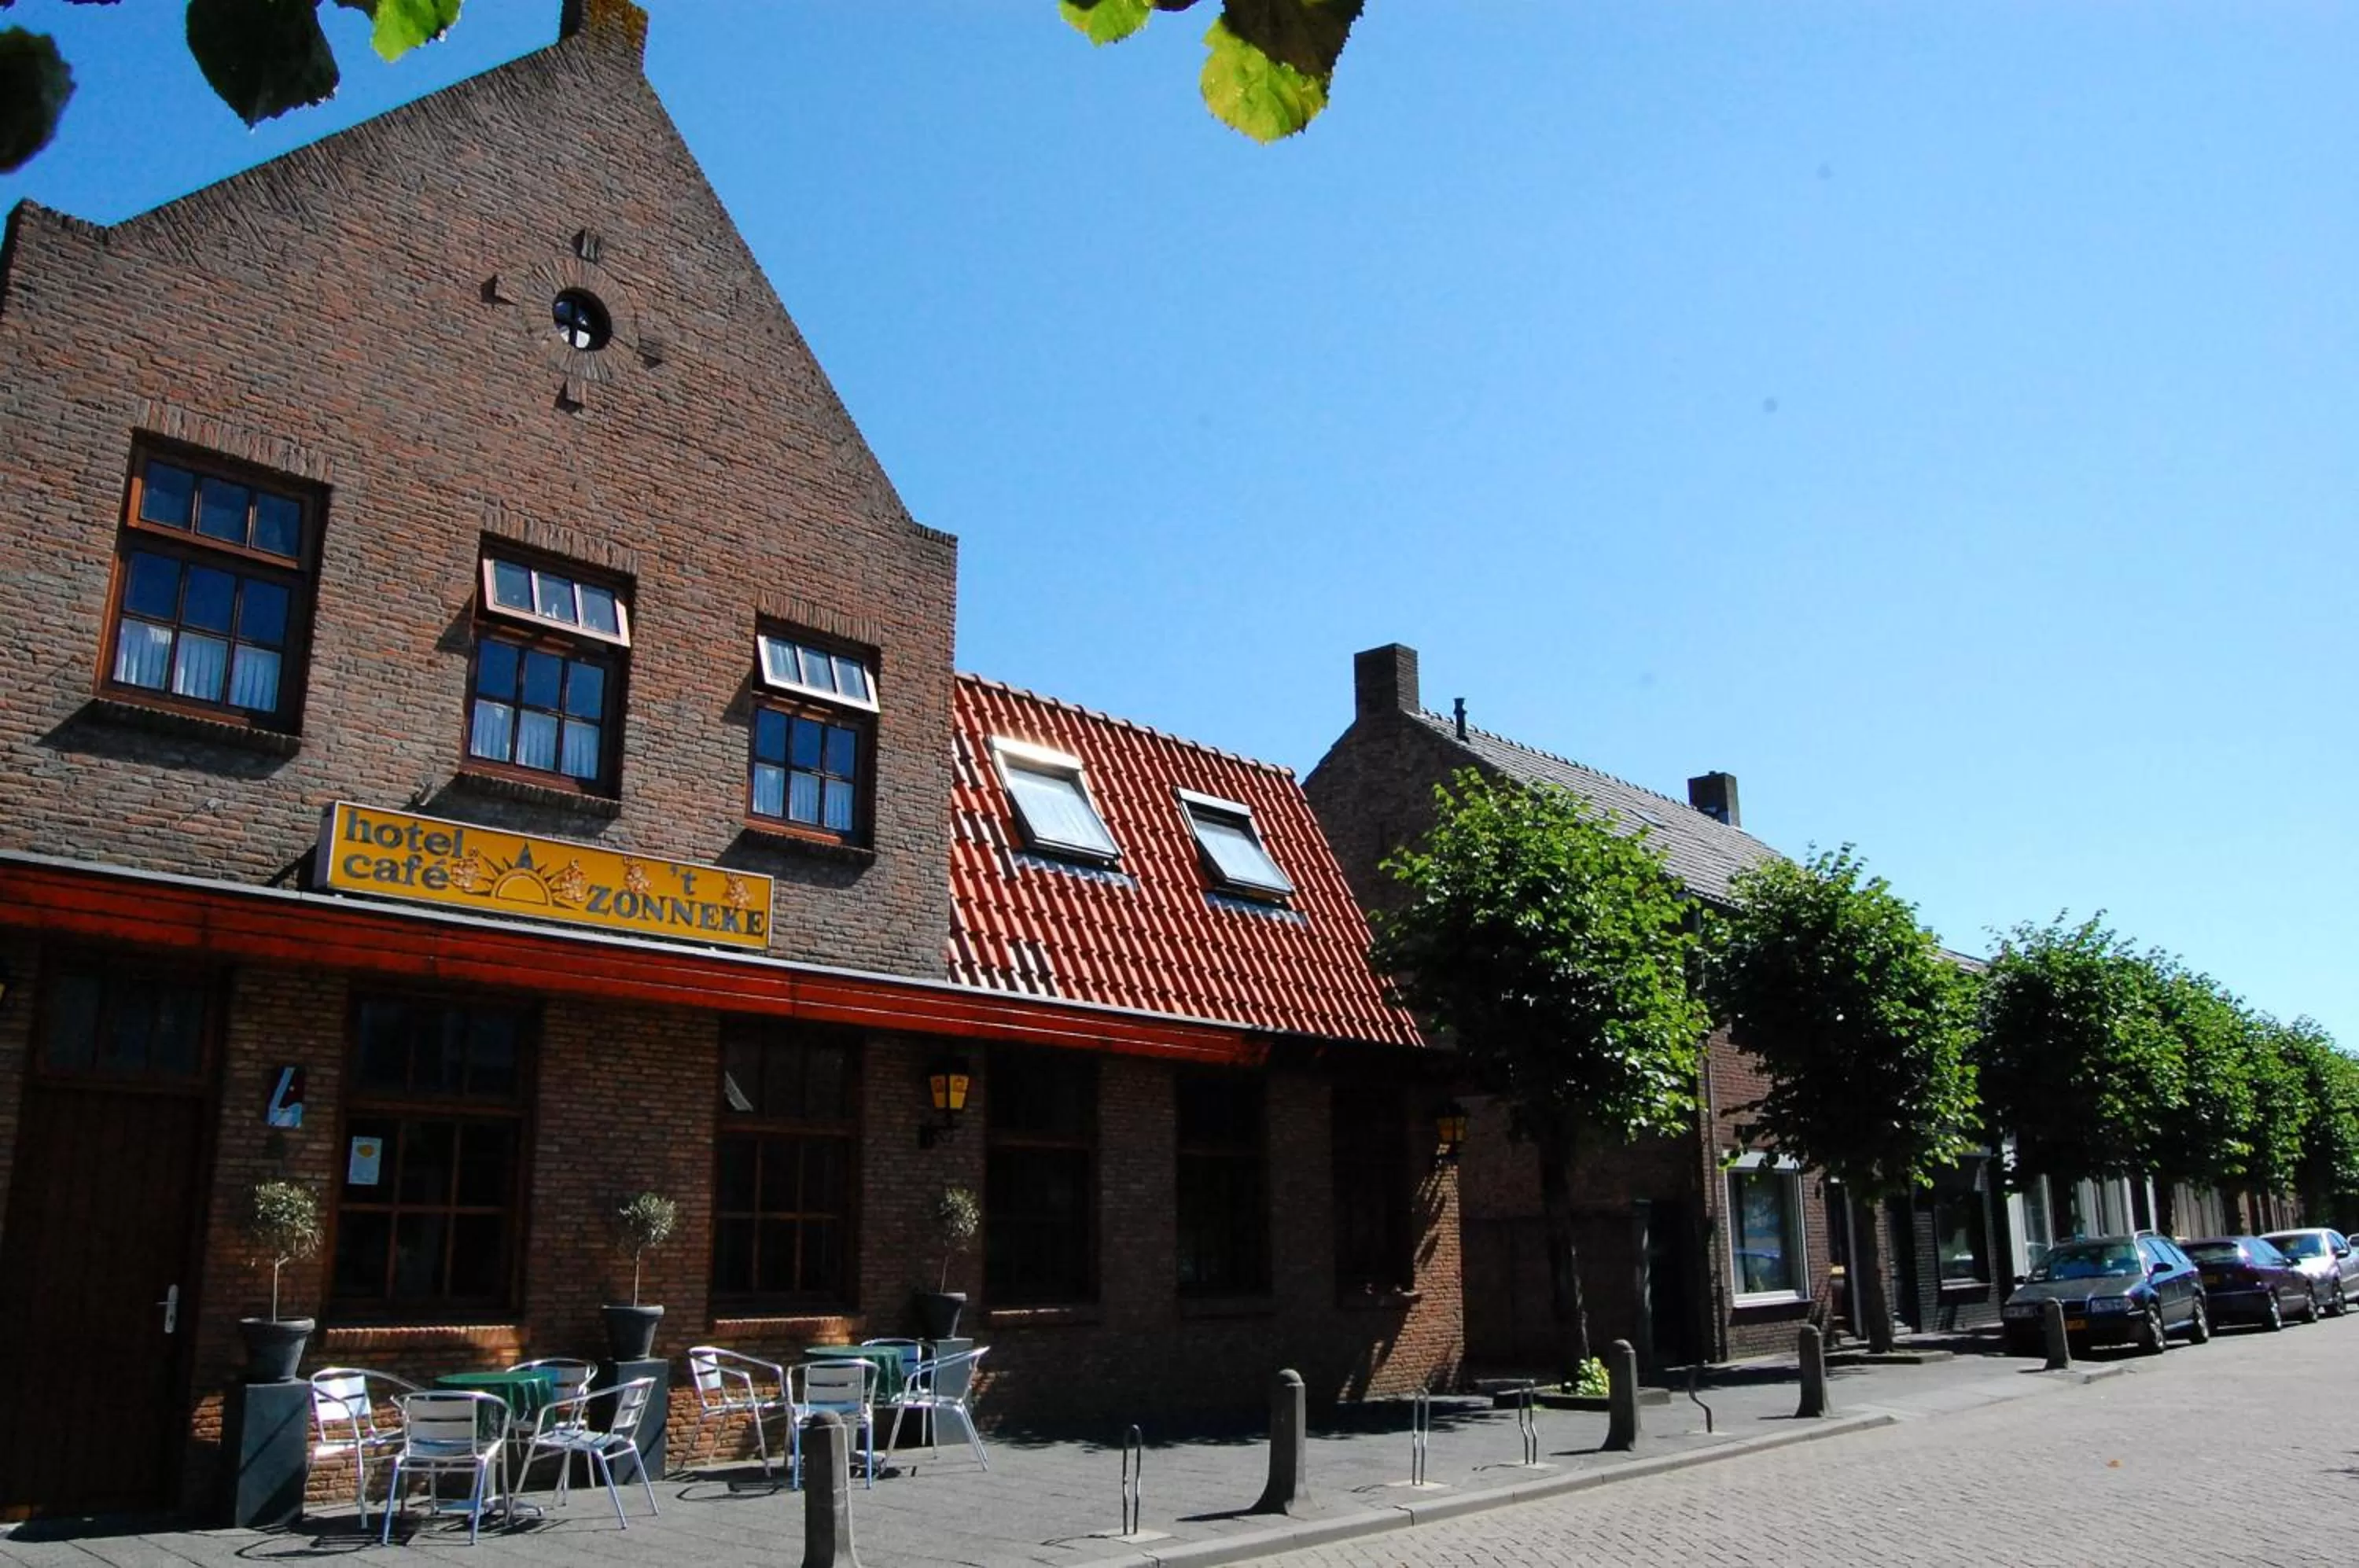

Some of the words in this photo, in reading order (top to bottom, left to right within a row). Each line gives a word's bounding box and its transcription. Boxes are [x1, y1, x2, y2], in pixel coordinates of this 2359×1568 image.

[344, 808, 464, 859] hotel
[342, 852, 449, 890] café
[669, 864, 697, 896] 't
[586, 883, 765, 937] ZONNEKE
